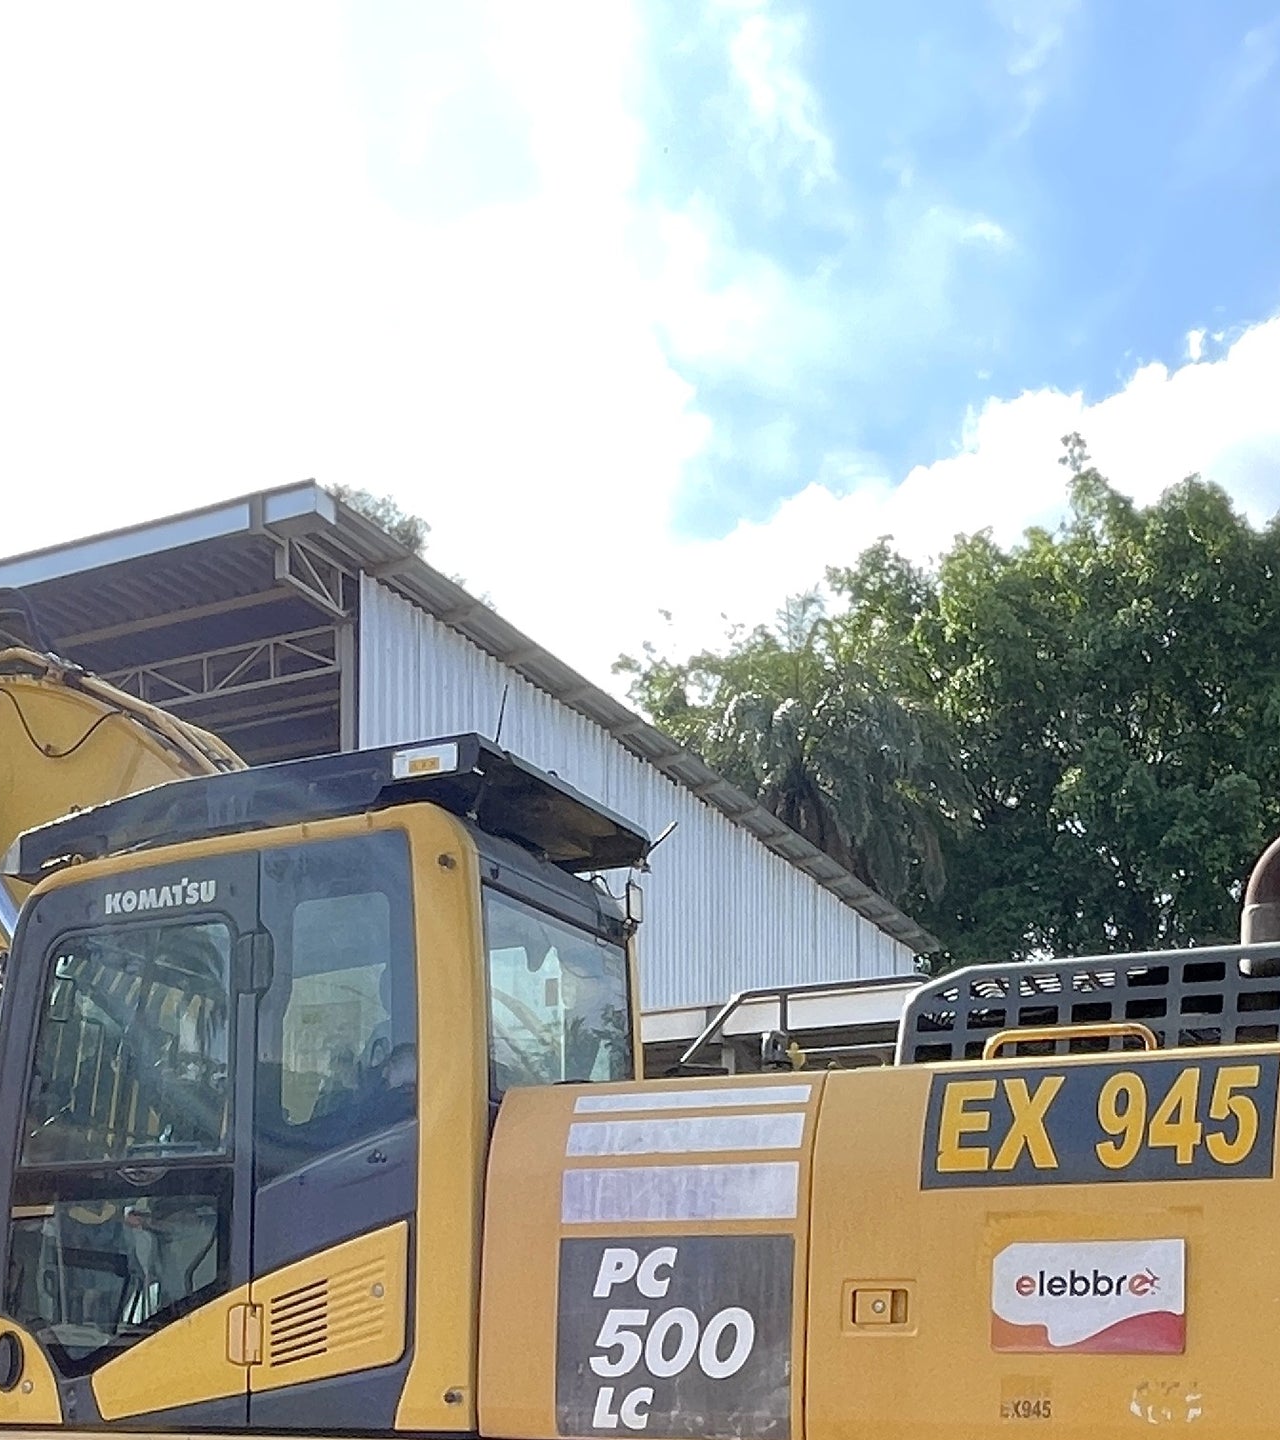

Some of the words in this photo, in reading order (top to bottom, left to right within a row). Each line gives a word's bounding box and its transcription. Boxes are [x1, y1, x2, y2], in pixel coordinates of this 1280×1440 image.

[104, 877, 216, 915] KOMATSU
[935, 1074, 1065, 1172] EX
[1095, 1065, 1261, 1169] 945
[592, 1247, 678, 1298] PC
[1015, 1268, 1156, 1297] elebbre
[588, 1306, 755, 1379] 500
[592, 1386, 654, 1430] LC
